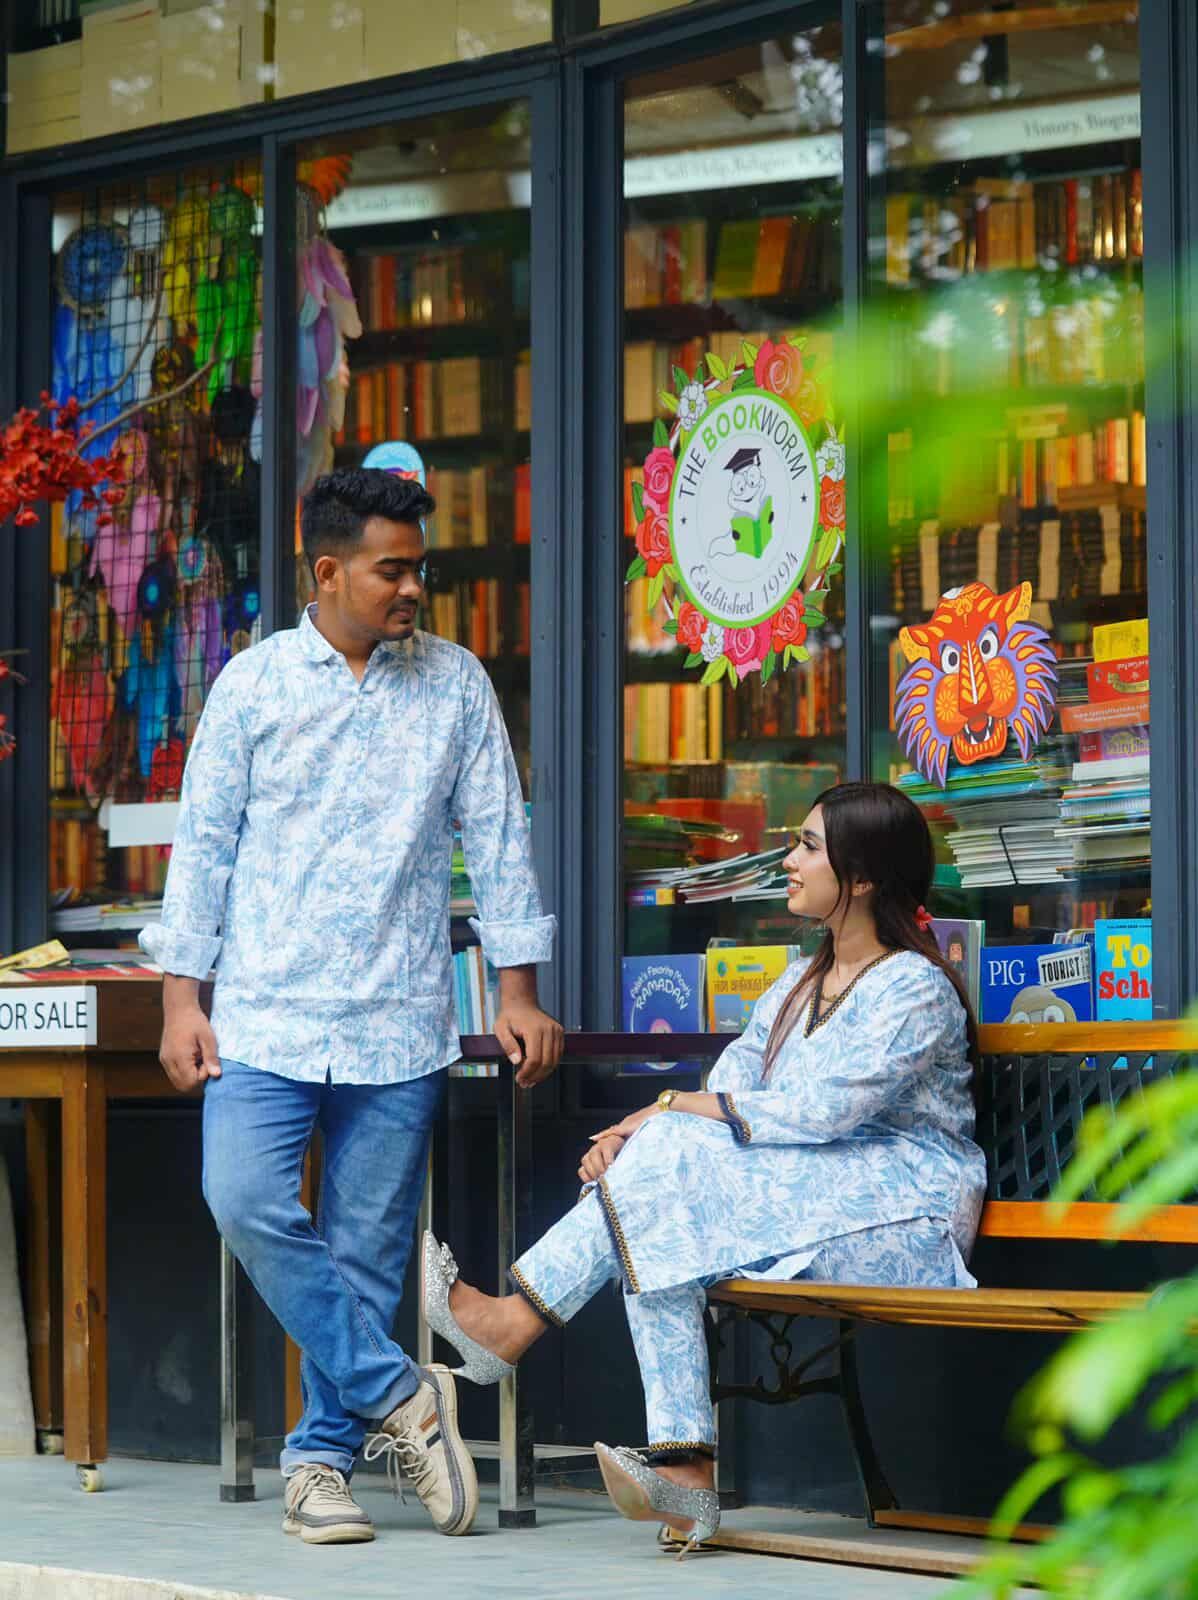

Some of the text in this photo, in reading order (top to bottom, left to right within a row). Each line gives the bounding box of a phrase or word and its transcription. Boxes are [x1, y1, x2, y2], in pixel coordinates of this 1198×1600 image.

[678, 403, 808, 499] THE BOOKWORM
[690, 564, 754, 615] Established
[988, 959, 1026, 986] PIG
[1041, 956, 1080, 983] TOURIST
[636, 978, 688, 1010] RAMADAN
[1099, 970, 1152, 1000] Sch
[34, 1001, 88, 1030] SALE
